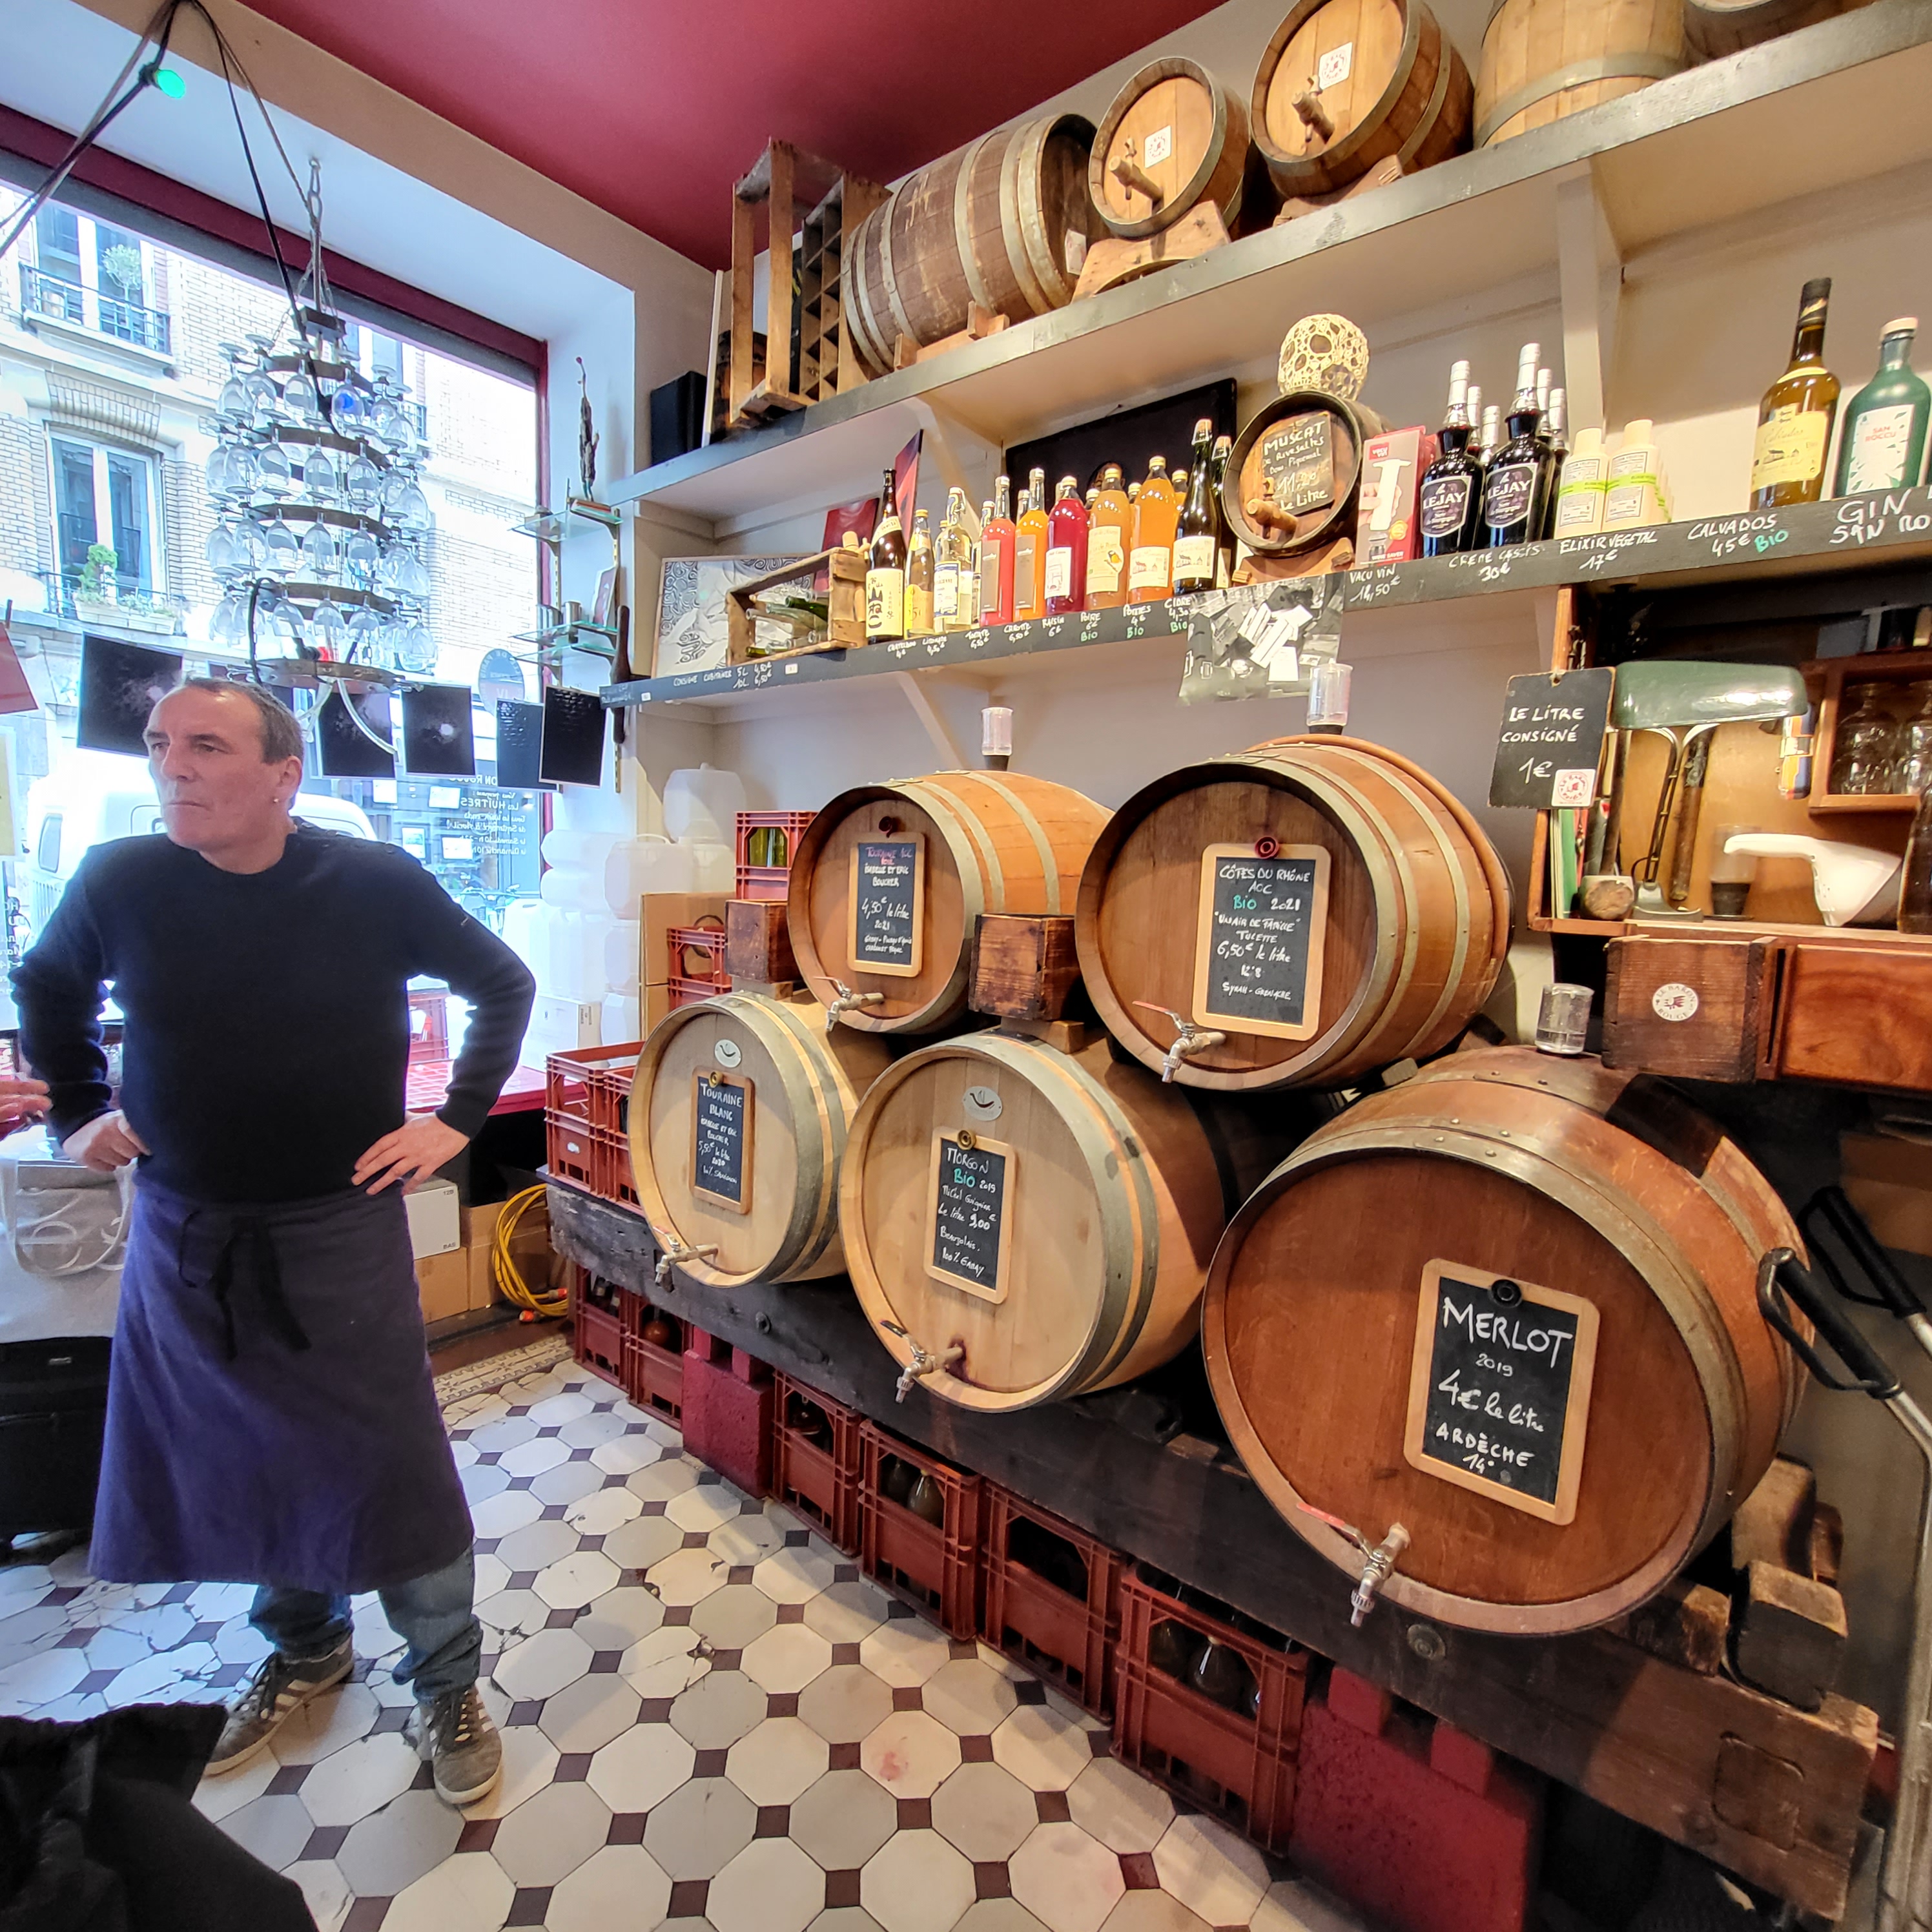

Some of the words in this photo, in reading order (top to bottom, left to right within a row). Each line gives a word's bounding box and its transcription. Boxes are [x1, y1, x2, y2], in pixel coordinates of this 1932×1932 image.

[1264, 421, 1326, 456] MUSCAT
[1865, 431, 1896, 442] ROCCU
[1873, 426, 1891, 434] SAN
[1276, 436, 1324, 461] Rivesaltes
[1487, 480, 1532, 500] LEJAY
[1423, 492, 1466, 509] LEJAY
[1836, 488, 1912, 524] GIN
[1687, 513, 1778, 540] CALVADOS
[1829, 519, 1884, 545] SAN
[1608, 531, 1658, 548] VEGETAL
[1712, 533, 1751, 557] 45€
[1579, 549, 1618, 571] 17€
[1350, 570, 1373, 584] VACU
[1123, 604, 1151, 617] POMMES
[1164, 597, 1191, 608] CIDRE
[1080, 611, 1102, 622] POIRE
[1131, 615, 1146, 625] 4€
[1003, 623, 1033, 633] CAROTTE
[1048, 626, 1062, 637] 6€
[1085, 621, 1098, 630] 6€
[737, 668, 748, 677] 5L
[1508, 707, 1530, 723] LE
[1519, 757, 1553, 785] 1€
[887, 866, 896, 874] ET
[1219, 863, 1255, 880] CÔTES
[1257, 868, 1273, 879] DU
[872, 876, 899, 887] BOUCHER
[1248, 880, 1273, 894] AOC
[1270, 898, 1301, 911] 2021
[874, 920, 890, 930] 2021
[1249, 918, 1261, 927] DE
[1236, 930, 1278, 943] TULETTE
[1217, 940, 1253, 960] 6,50€
[1269, 946, 1291, 962] litre
[1222, 981, 1248, 996] SYRAH
[1255, 987, 1291, 1001] GRENACHE
[1668, 985, 1696, 1002] BARON
[700, 1083, 743, 1108] TOURAINE
[709, 1104, 733, 1121] BLANC
[720, 1125, 728, 1133] ET
[707, 1130, 729, 1146] BOUCHER
[711, 1156, 726, 1167] 2020
[947, 1147, 989, 1175] MORGON
[980, 1180, 996, 1193] 2019
[938, 1202, 948, 1217] Le
[950, 1206, 965, 1222] litre
[960, 1256, 985, 1278] GAMAY
[1442, 1296, 1574, 1369] MERLOT
[1475, 1353, 1514, 1377] 2019
[1437, 1368, 1482, 1411] 4€
[1485, 1392, 1505, 1419] le
[1508, 1403, 1545, 1433] litre
[1435, 1421, 1536, 1468] ARDÈCHE
